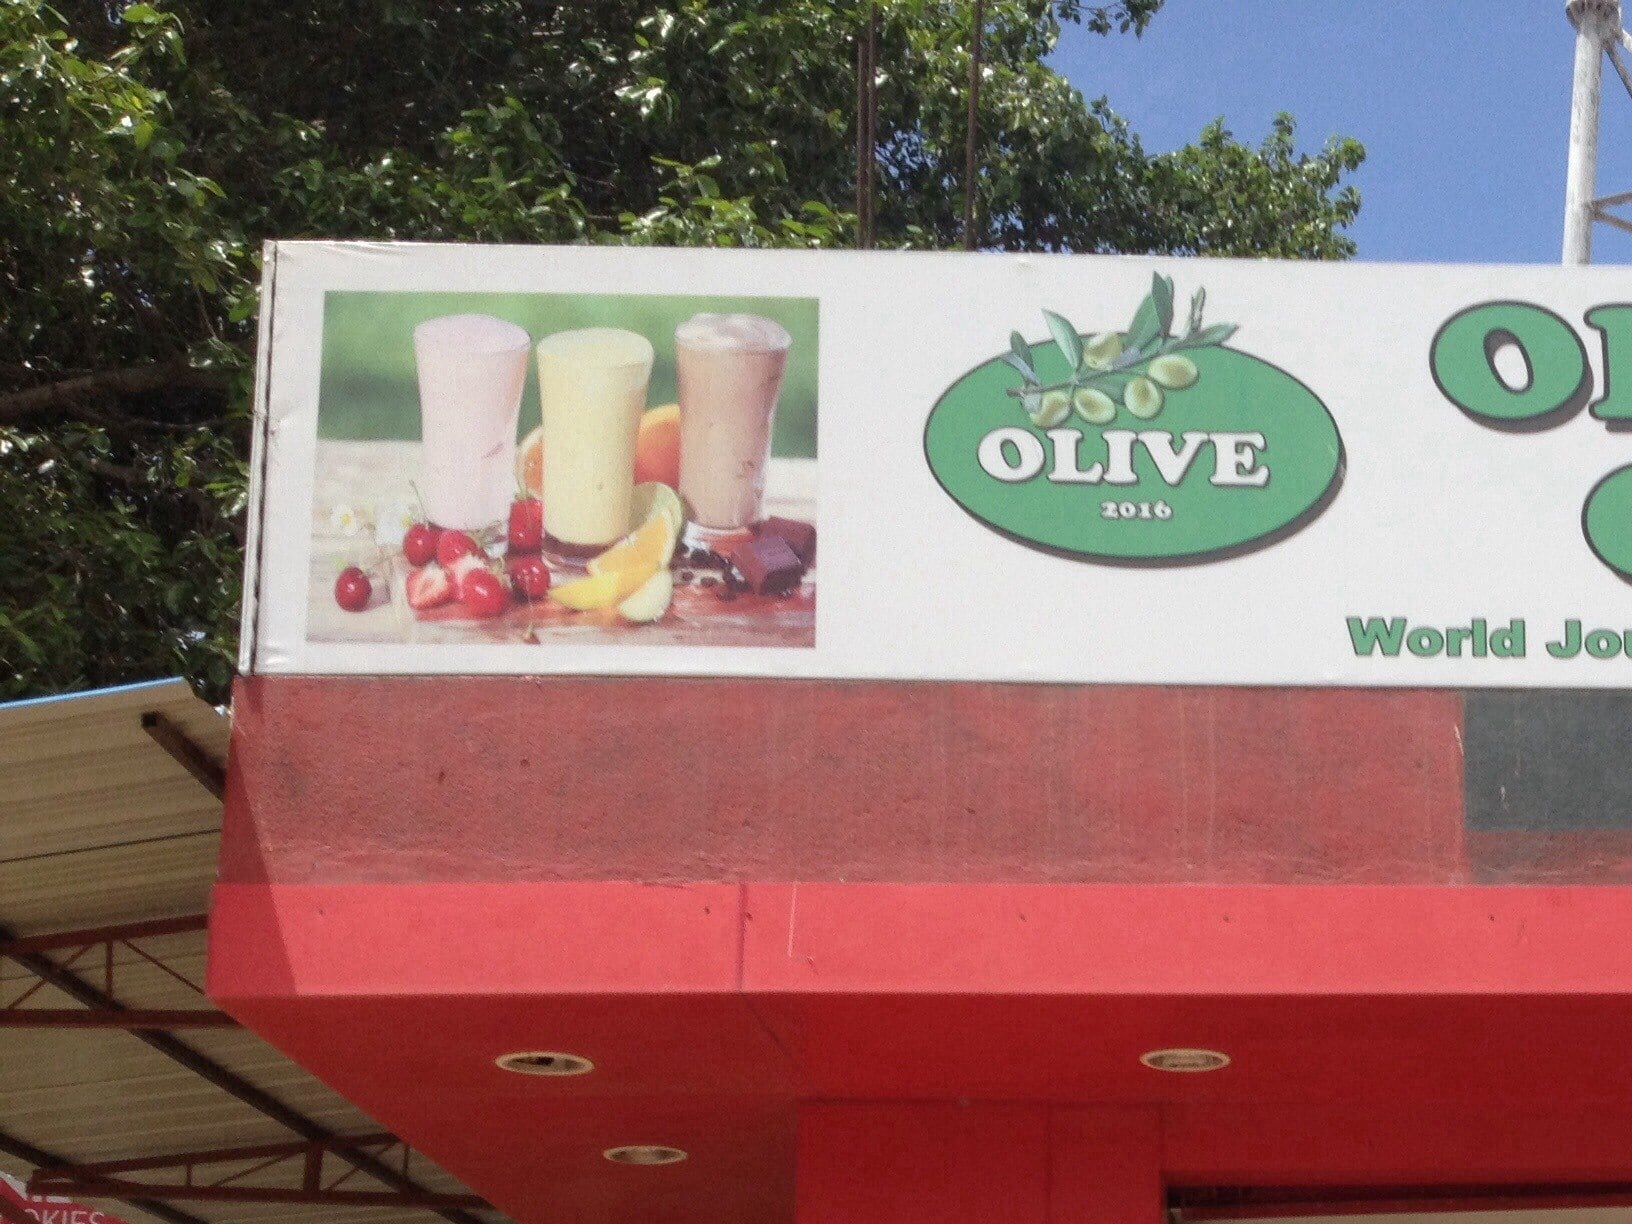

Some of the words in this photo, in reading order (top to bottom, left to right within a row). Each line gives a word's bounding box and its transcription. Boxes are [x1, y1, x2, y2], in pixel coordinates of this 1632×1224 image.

[978, 426, 1271, 488] OLIVE
[1101, 499, 1173, 520] 2016
[1346, 616, 1528, 660] World
